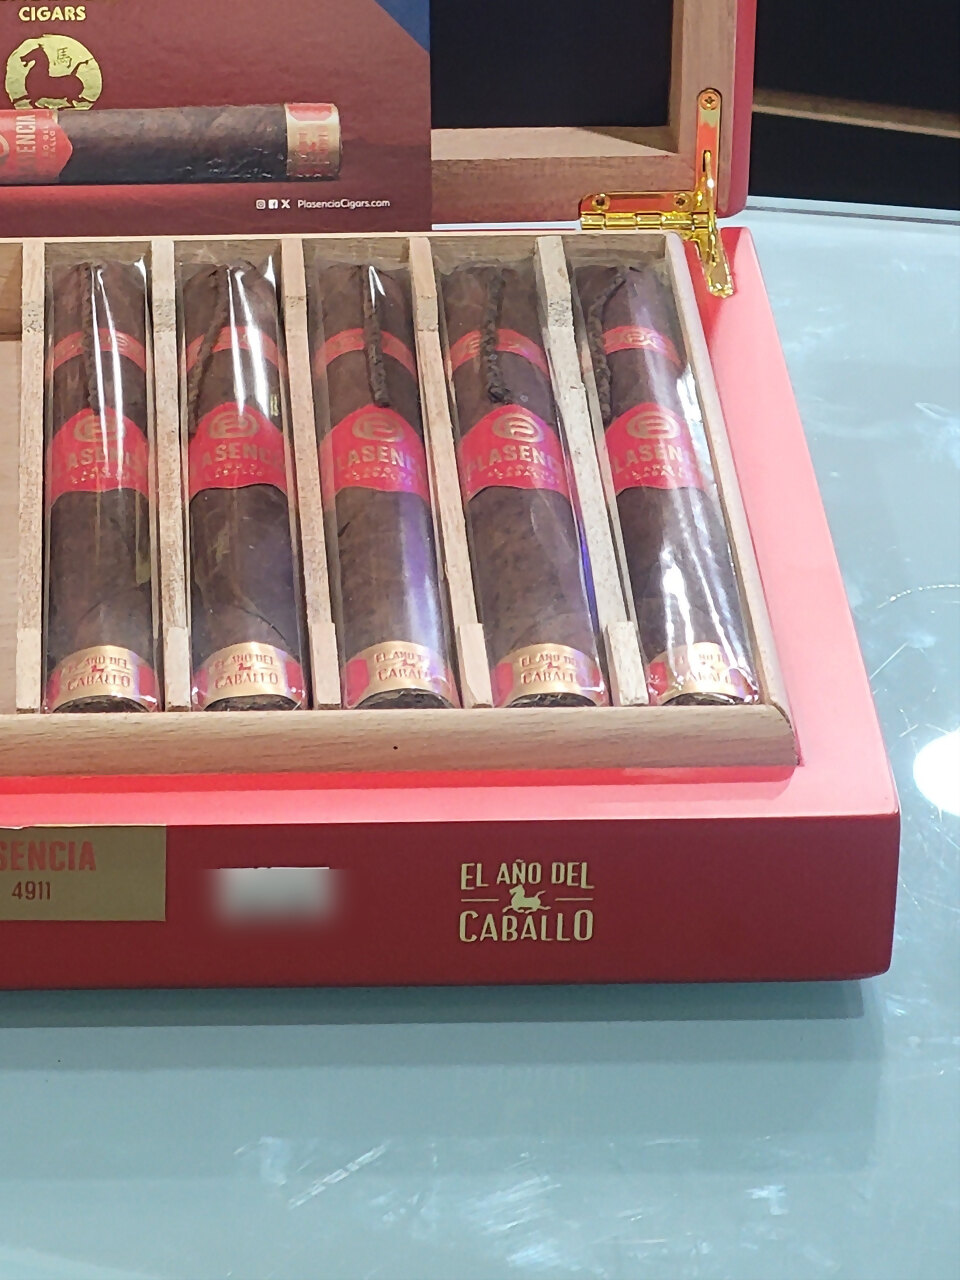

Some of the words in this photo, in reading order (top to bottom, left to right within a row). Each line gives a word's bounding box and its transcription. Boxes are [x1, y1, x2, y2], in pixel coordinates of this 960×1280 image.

[18, 6, 86, 21] CIGARS
[297, 199, 390, 210] PlasenciaCigars.com
[67, 674, 132, 691] CABALLO
[214, 672, 279, 689] CABALLO
[460, 862, 489, 890] EL
[496, 858, 541, 885] AÑO
[551, 862, 594, 889] DEL
[11, 881, 51, 900] 4911
[459, 910, 594, 942] CABALLO
